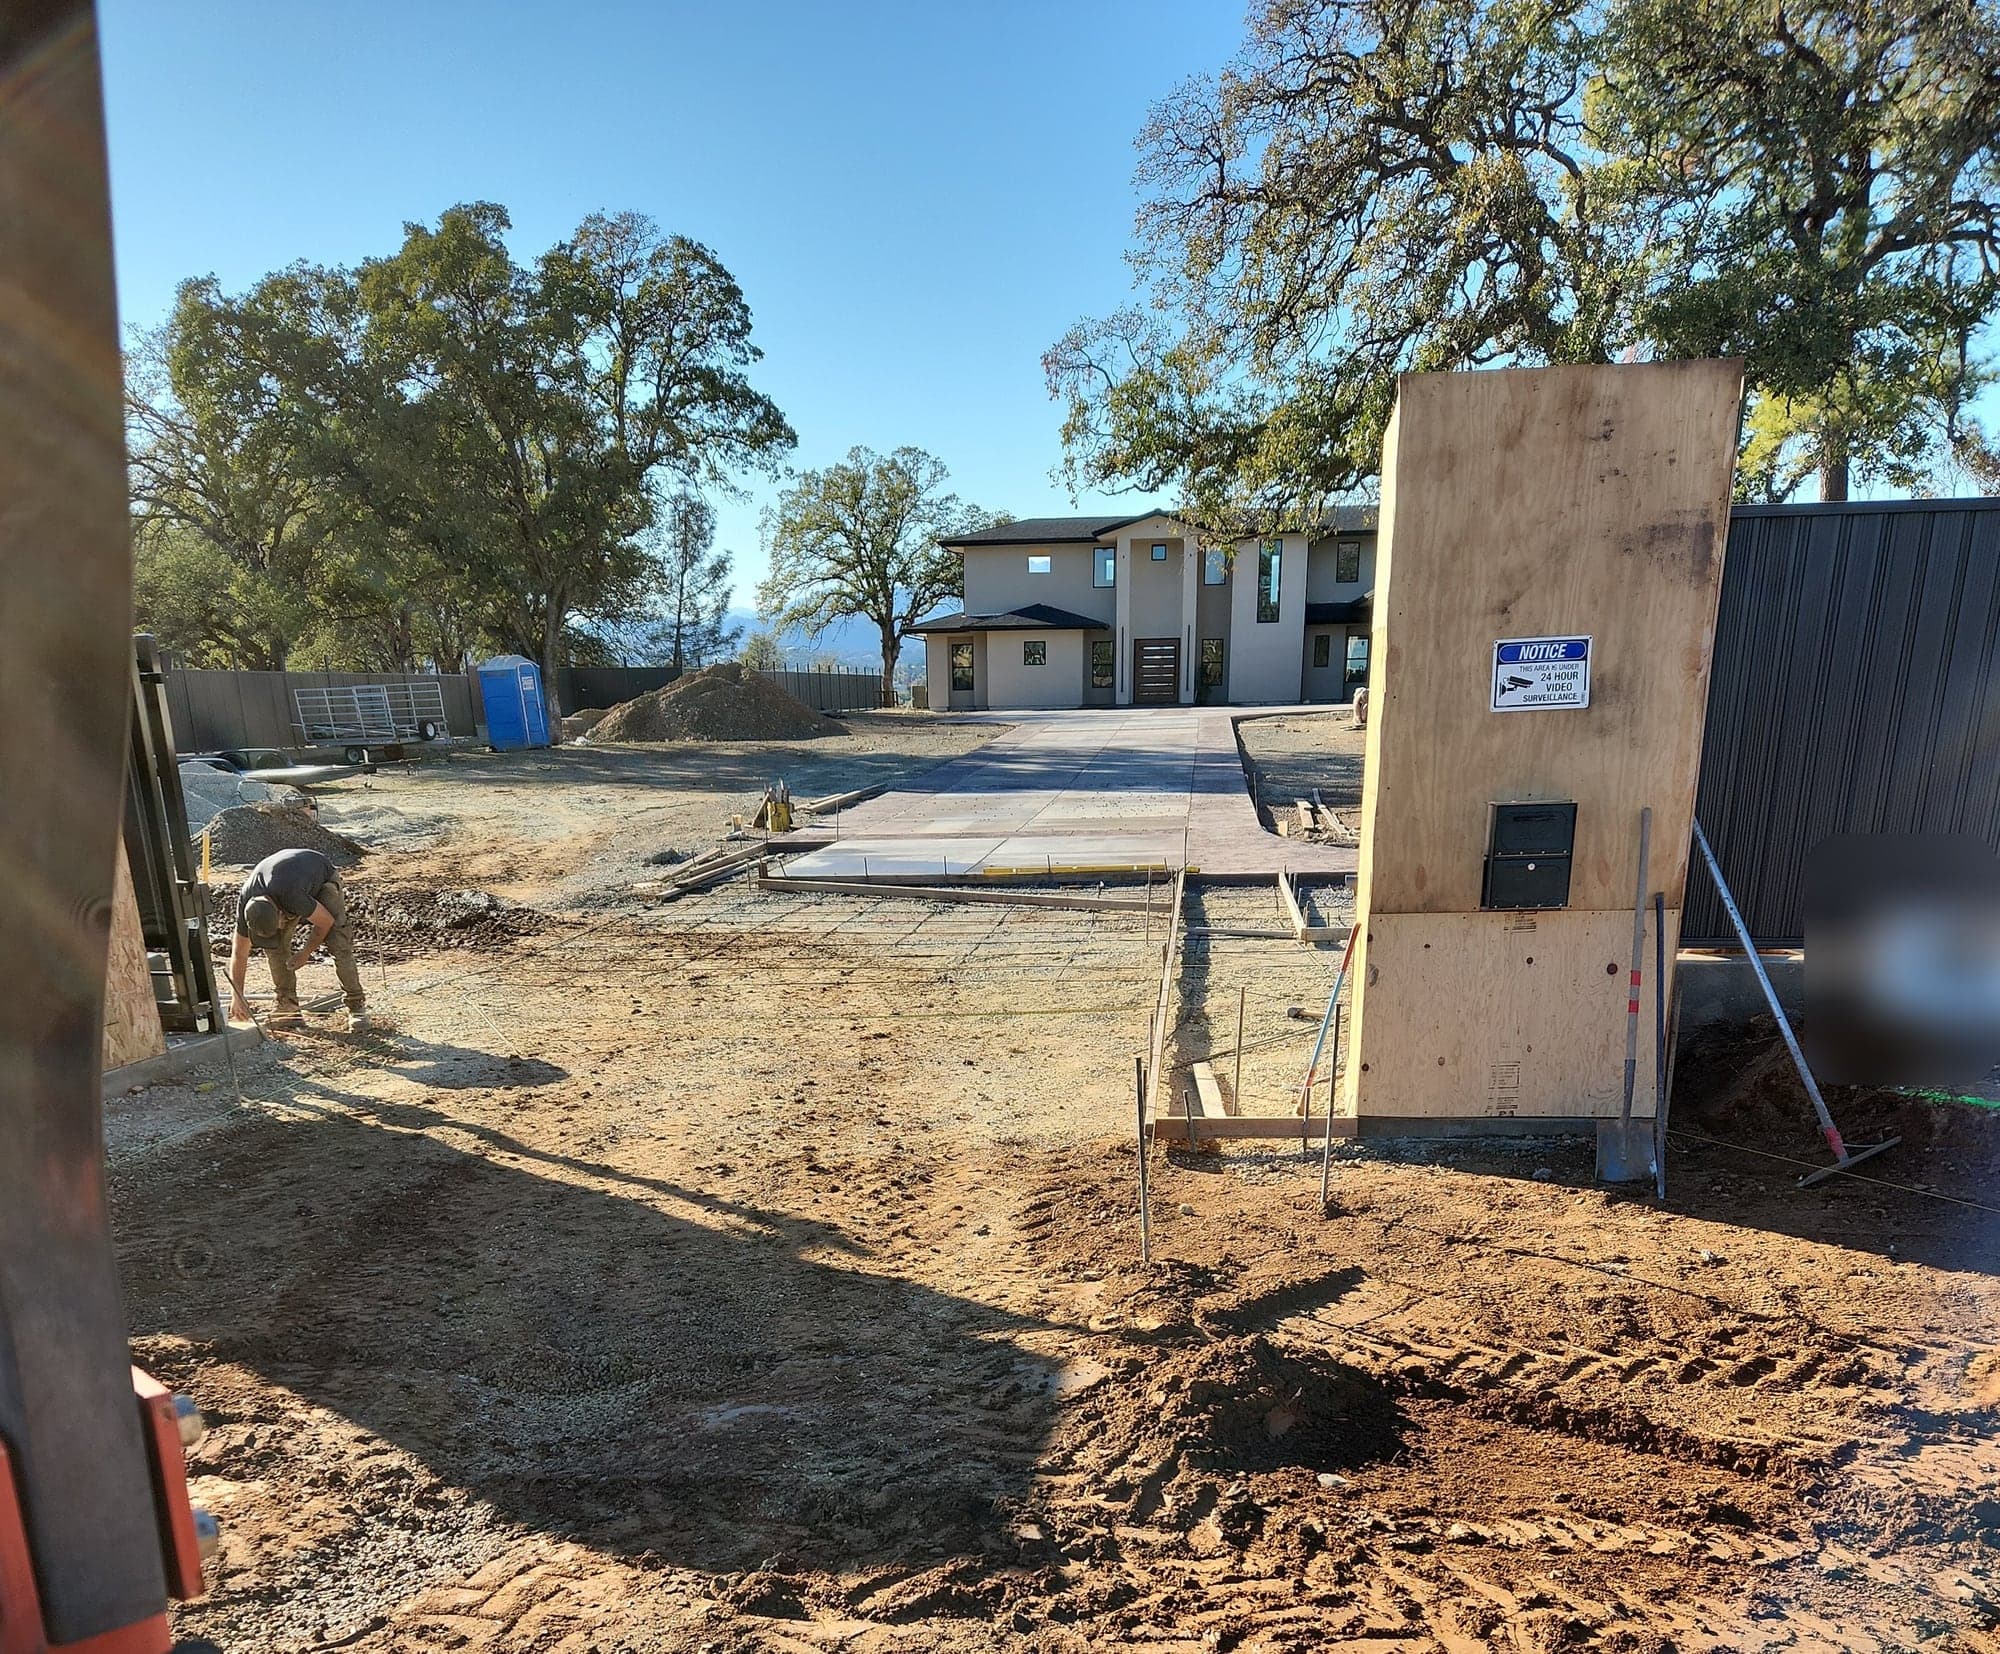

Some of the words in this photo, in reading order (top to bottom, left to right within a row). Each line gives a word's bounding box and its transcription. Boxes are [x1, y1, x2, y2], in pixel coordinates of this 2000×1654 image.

[1519, 643, 1567, 660] NOTICE
[1541, 673, 1551, 681] 24
[1554, 671, 1579, 681] HOUR
[1546, 683, 1572, 692] VIDEO
[1523, 693, 1577, 703] SURVEILLANCE
